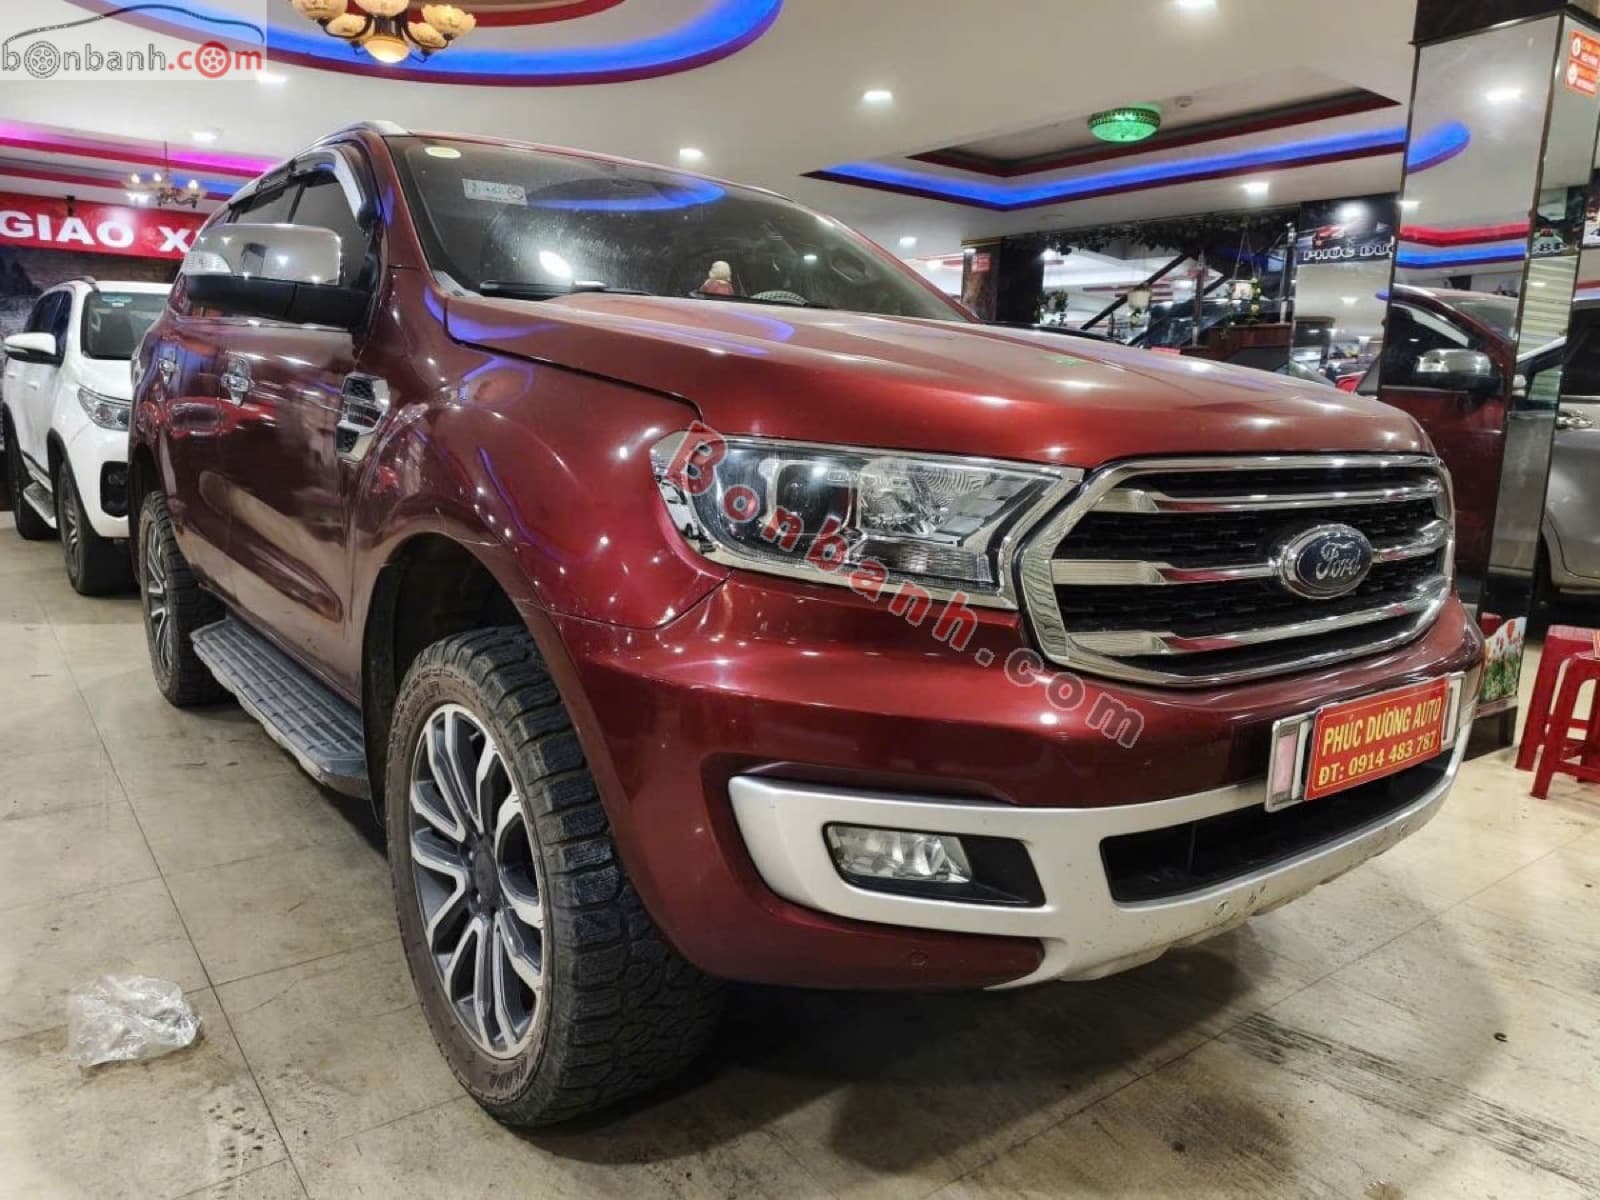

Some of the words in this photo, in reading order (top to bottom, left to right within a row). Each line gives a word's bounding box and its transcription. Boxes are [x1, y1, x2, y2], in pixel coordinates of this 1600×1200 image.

[0, 210, 134, 248] GIAO
[159, 226, 201, 253] X
[1315, 541, 1361, 580] Ford
[1322, 713, 1363, 757] PHÚC
[1412, 696, 1442, 730] AUTO
[1318, 762, 1345, 786] ĐT:
[1348, 748, 1385, 776] 0914
[1388, 739, 1414, 762] 483
[1415, 730, 1437, 753] 787
